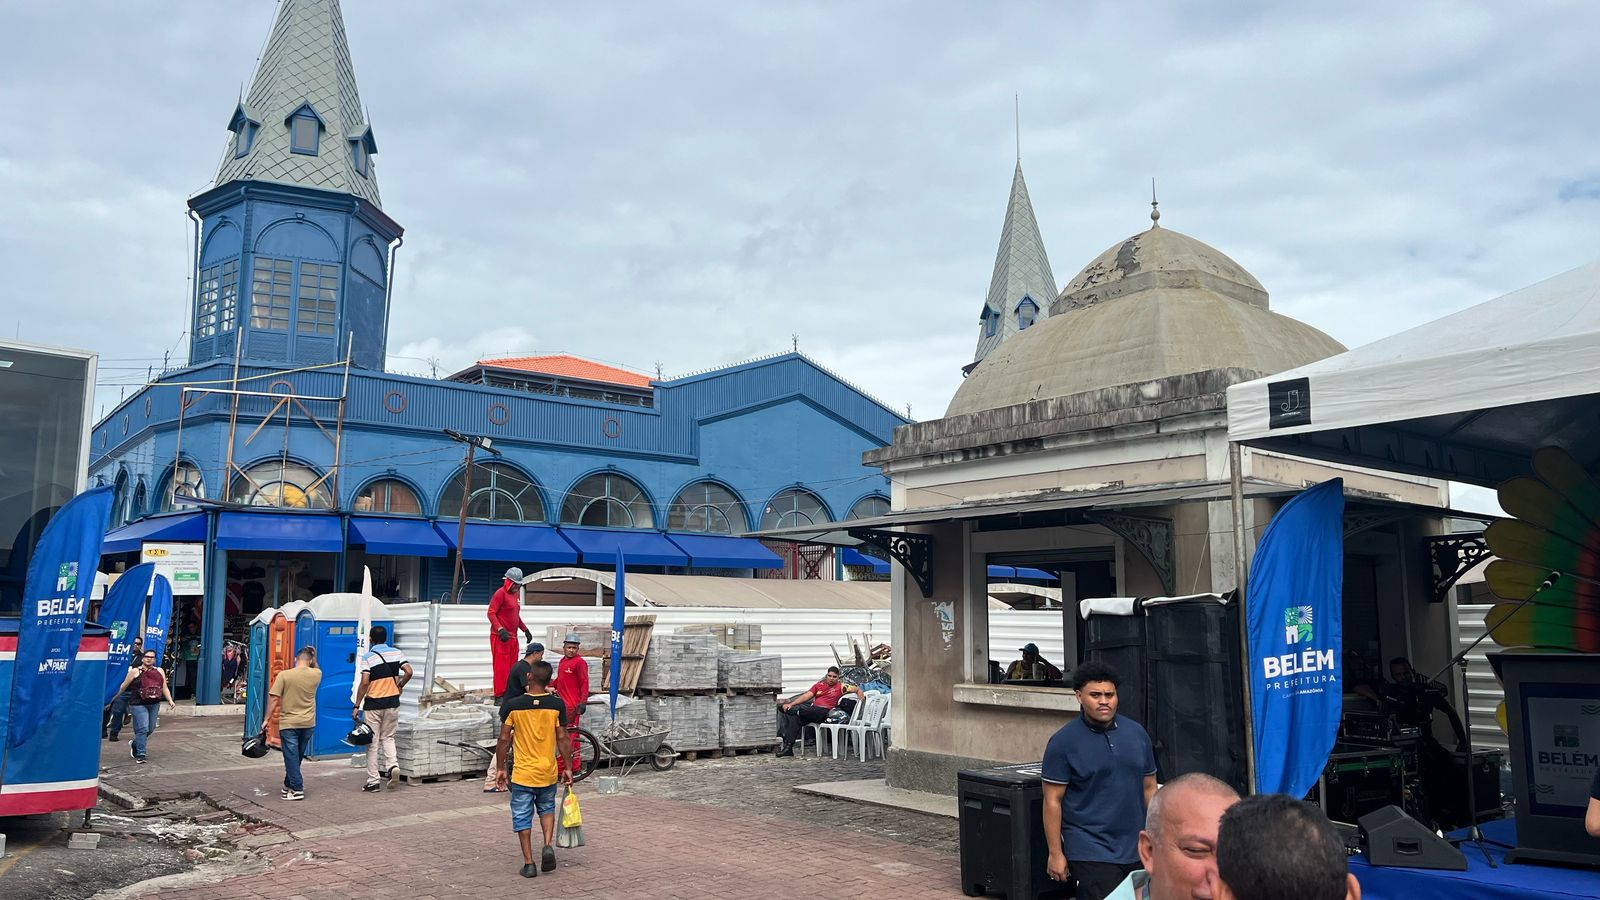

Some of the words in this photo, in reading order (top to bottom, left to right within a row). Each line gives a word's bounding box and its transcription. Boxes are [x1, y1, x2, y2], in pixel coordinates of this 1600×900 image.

[37, 595, 84, 617] BELÉM
[1263, 647, 1334, 679] BELÉM
[1266, 675, 1336, 690] PREFEITURA
[1538, 751, 1598, 767] BELÉM
